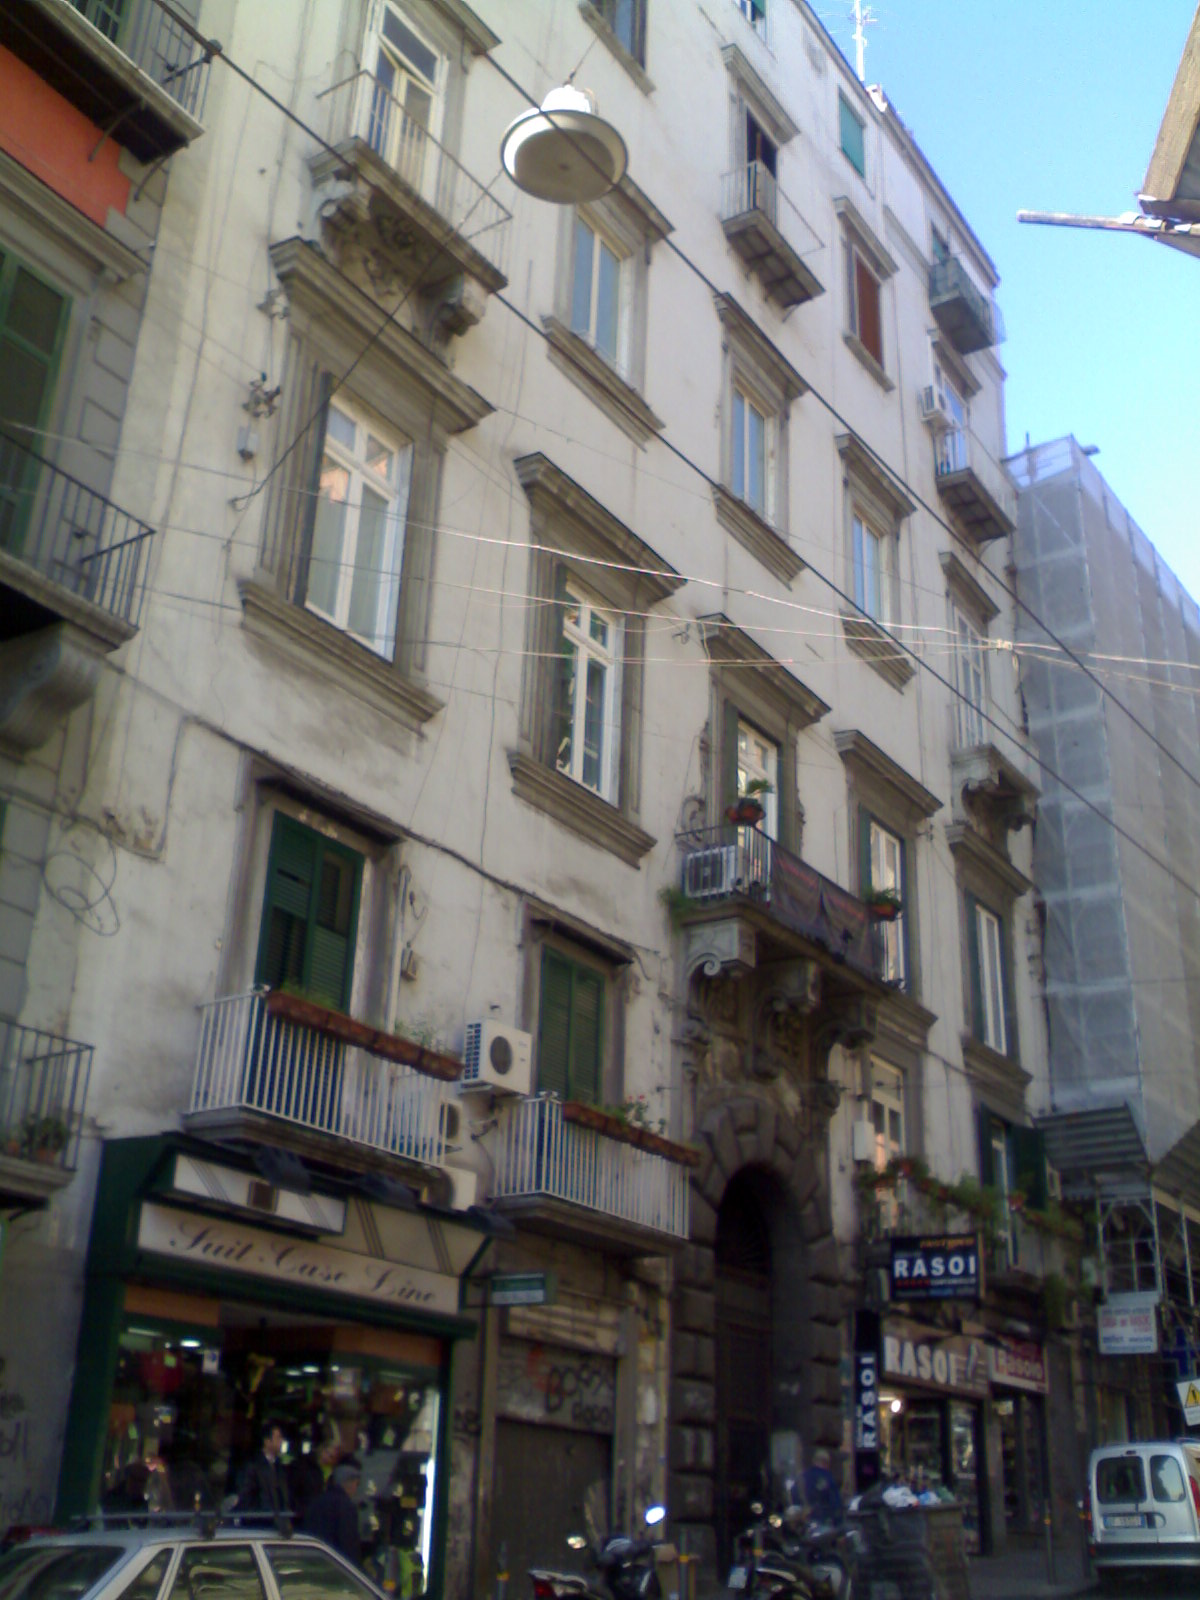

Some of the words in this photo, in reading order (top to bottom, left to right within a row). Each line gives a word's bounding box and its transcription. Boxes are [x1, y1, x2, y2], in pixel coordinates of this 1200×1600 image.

[366, 1262, 435, 1302] Line
[893, 1256, 976, 1279] RASOI
[883, 1336, 958, 1386] RASOI
[861, 1356, 876, 1448] RASOI
